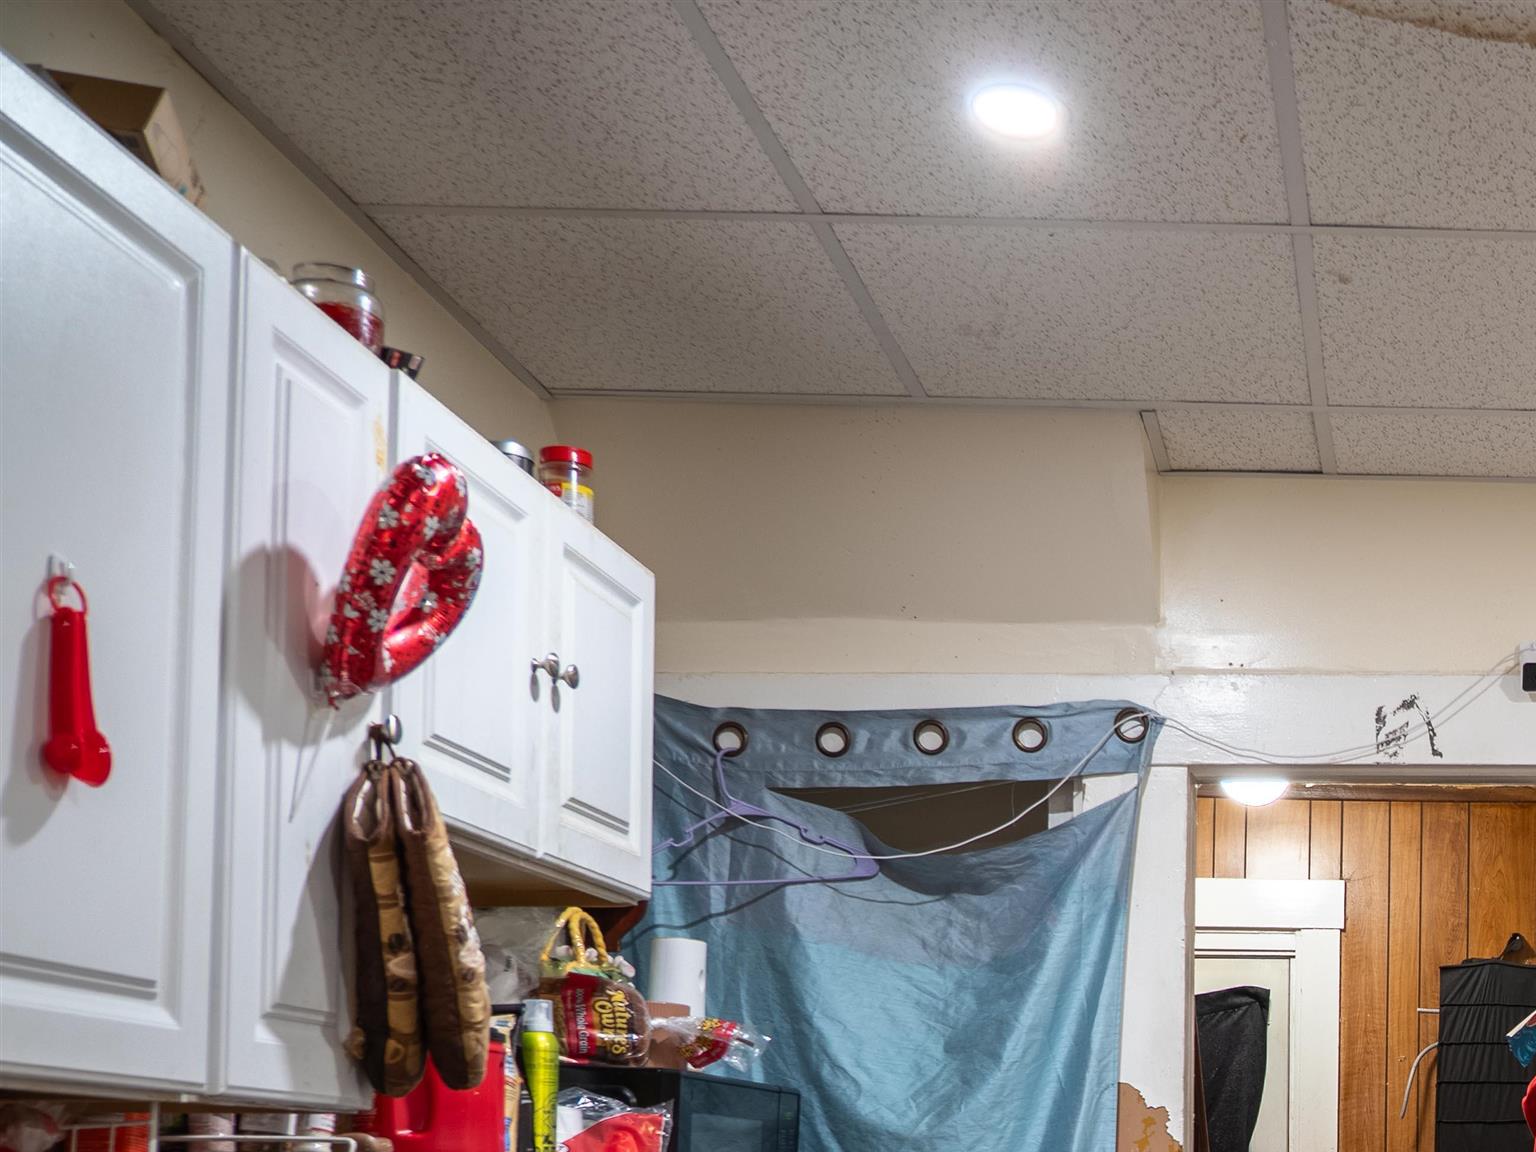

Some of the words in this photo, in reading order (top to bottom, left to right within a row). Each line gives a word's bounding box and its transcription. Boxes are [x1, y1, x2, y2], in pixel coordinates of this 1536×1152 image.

[575, 1004, 588, 1030] Whole
[593, 1000, 616, 1041] Own
[605, 988, 633, 1055] Nature's
[577, 1030, 590, 1054] Grain
